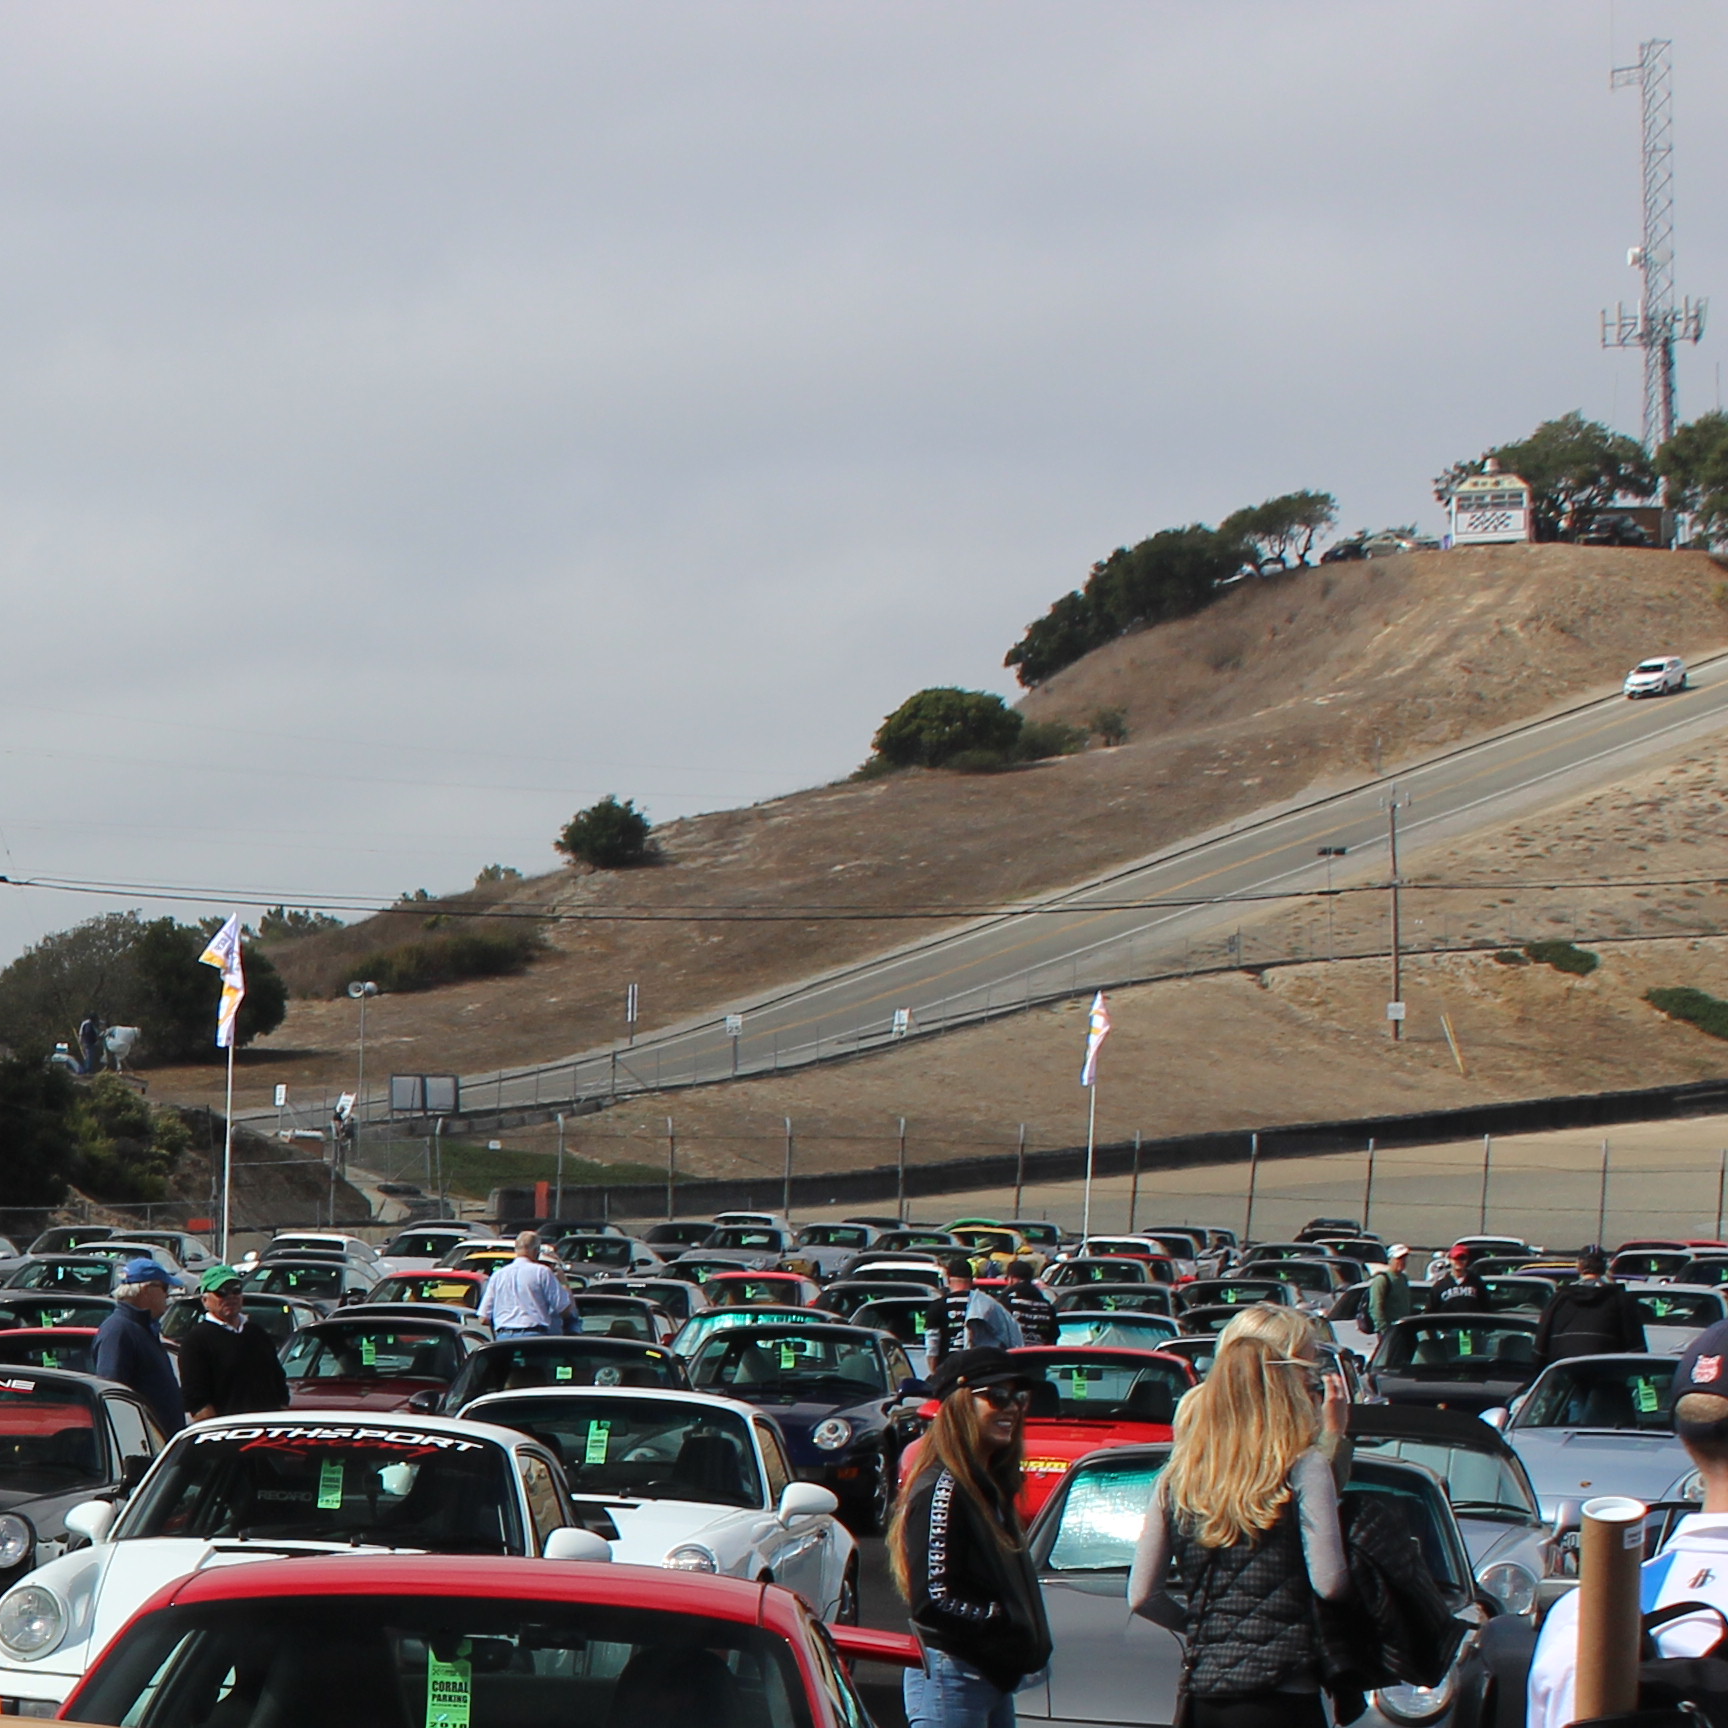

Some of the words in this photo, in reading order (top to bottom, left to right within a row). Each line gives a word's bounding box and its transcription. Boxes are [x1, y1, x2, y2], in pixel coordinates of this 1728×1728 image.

[194, 1427, 484, 1451] ROTHSPORT
[432, 1681, 469, 1693] CORRAL
[432, 1693, 468, 1703] PARKING
